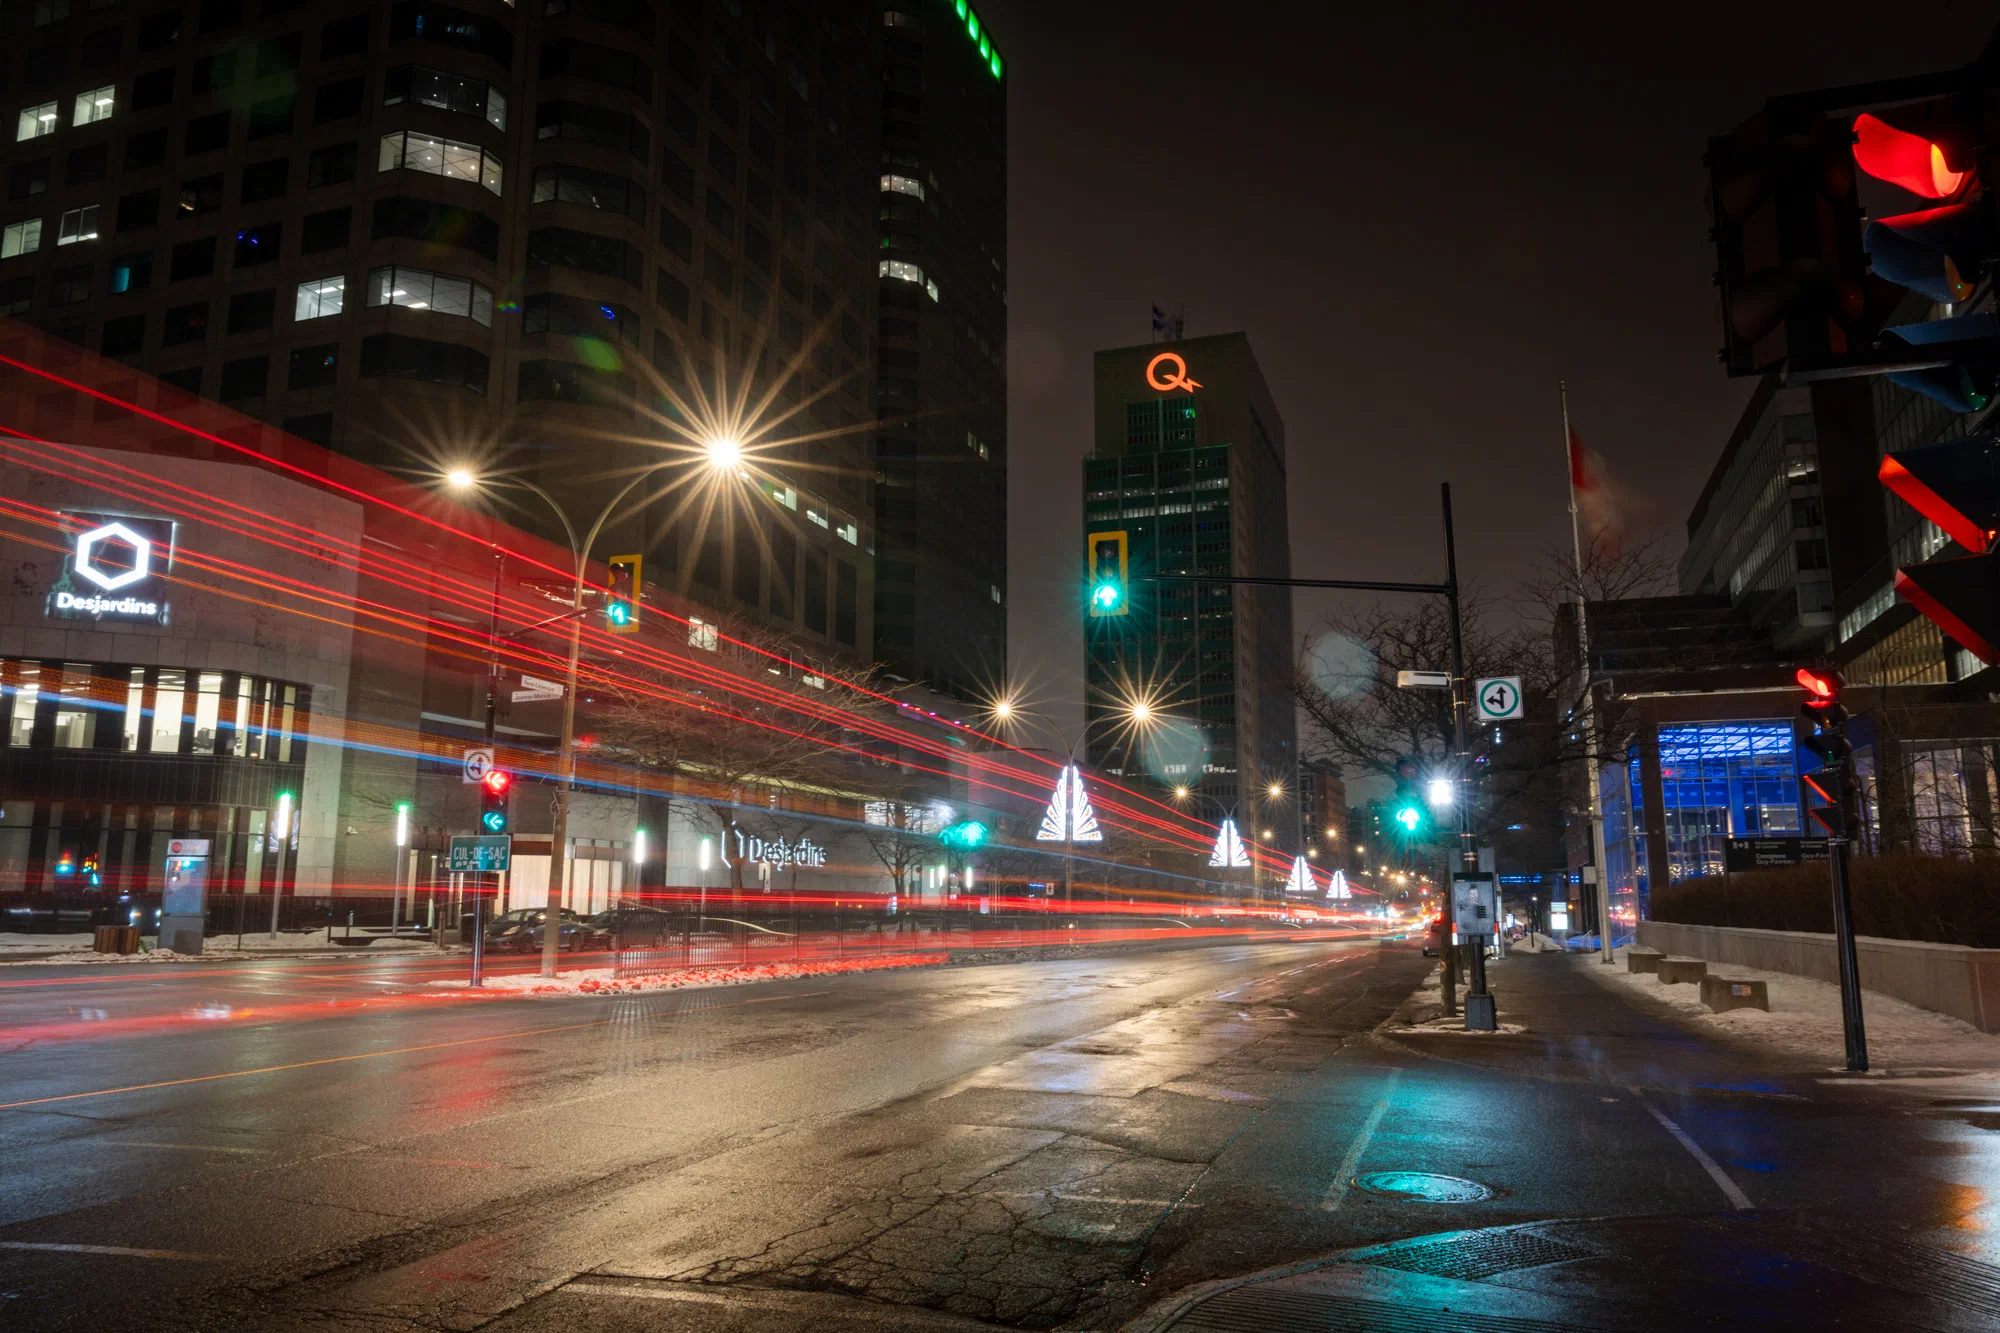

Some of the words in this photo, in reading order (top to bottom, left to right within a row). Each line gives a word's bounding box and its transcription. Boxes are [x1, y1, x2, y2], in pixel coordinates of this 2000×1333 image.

[57, 592, 157, 616] Desjardins
[453, 846, 506, 860] CUL-DE-SAC
[749, 836, 827, 871] Desjardins
